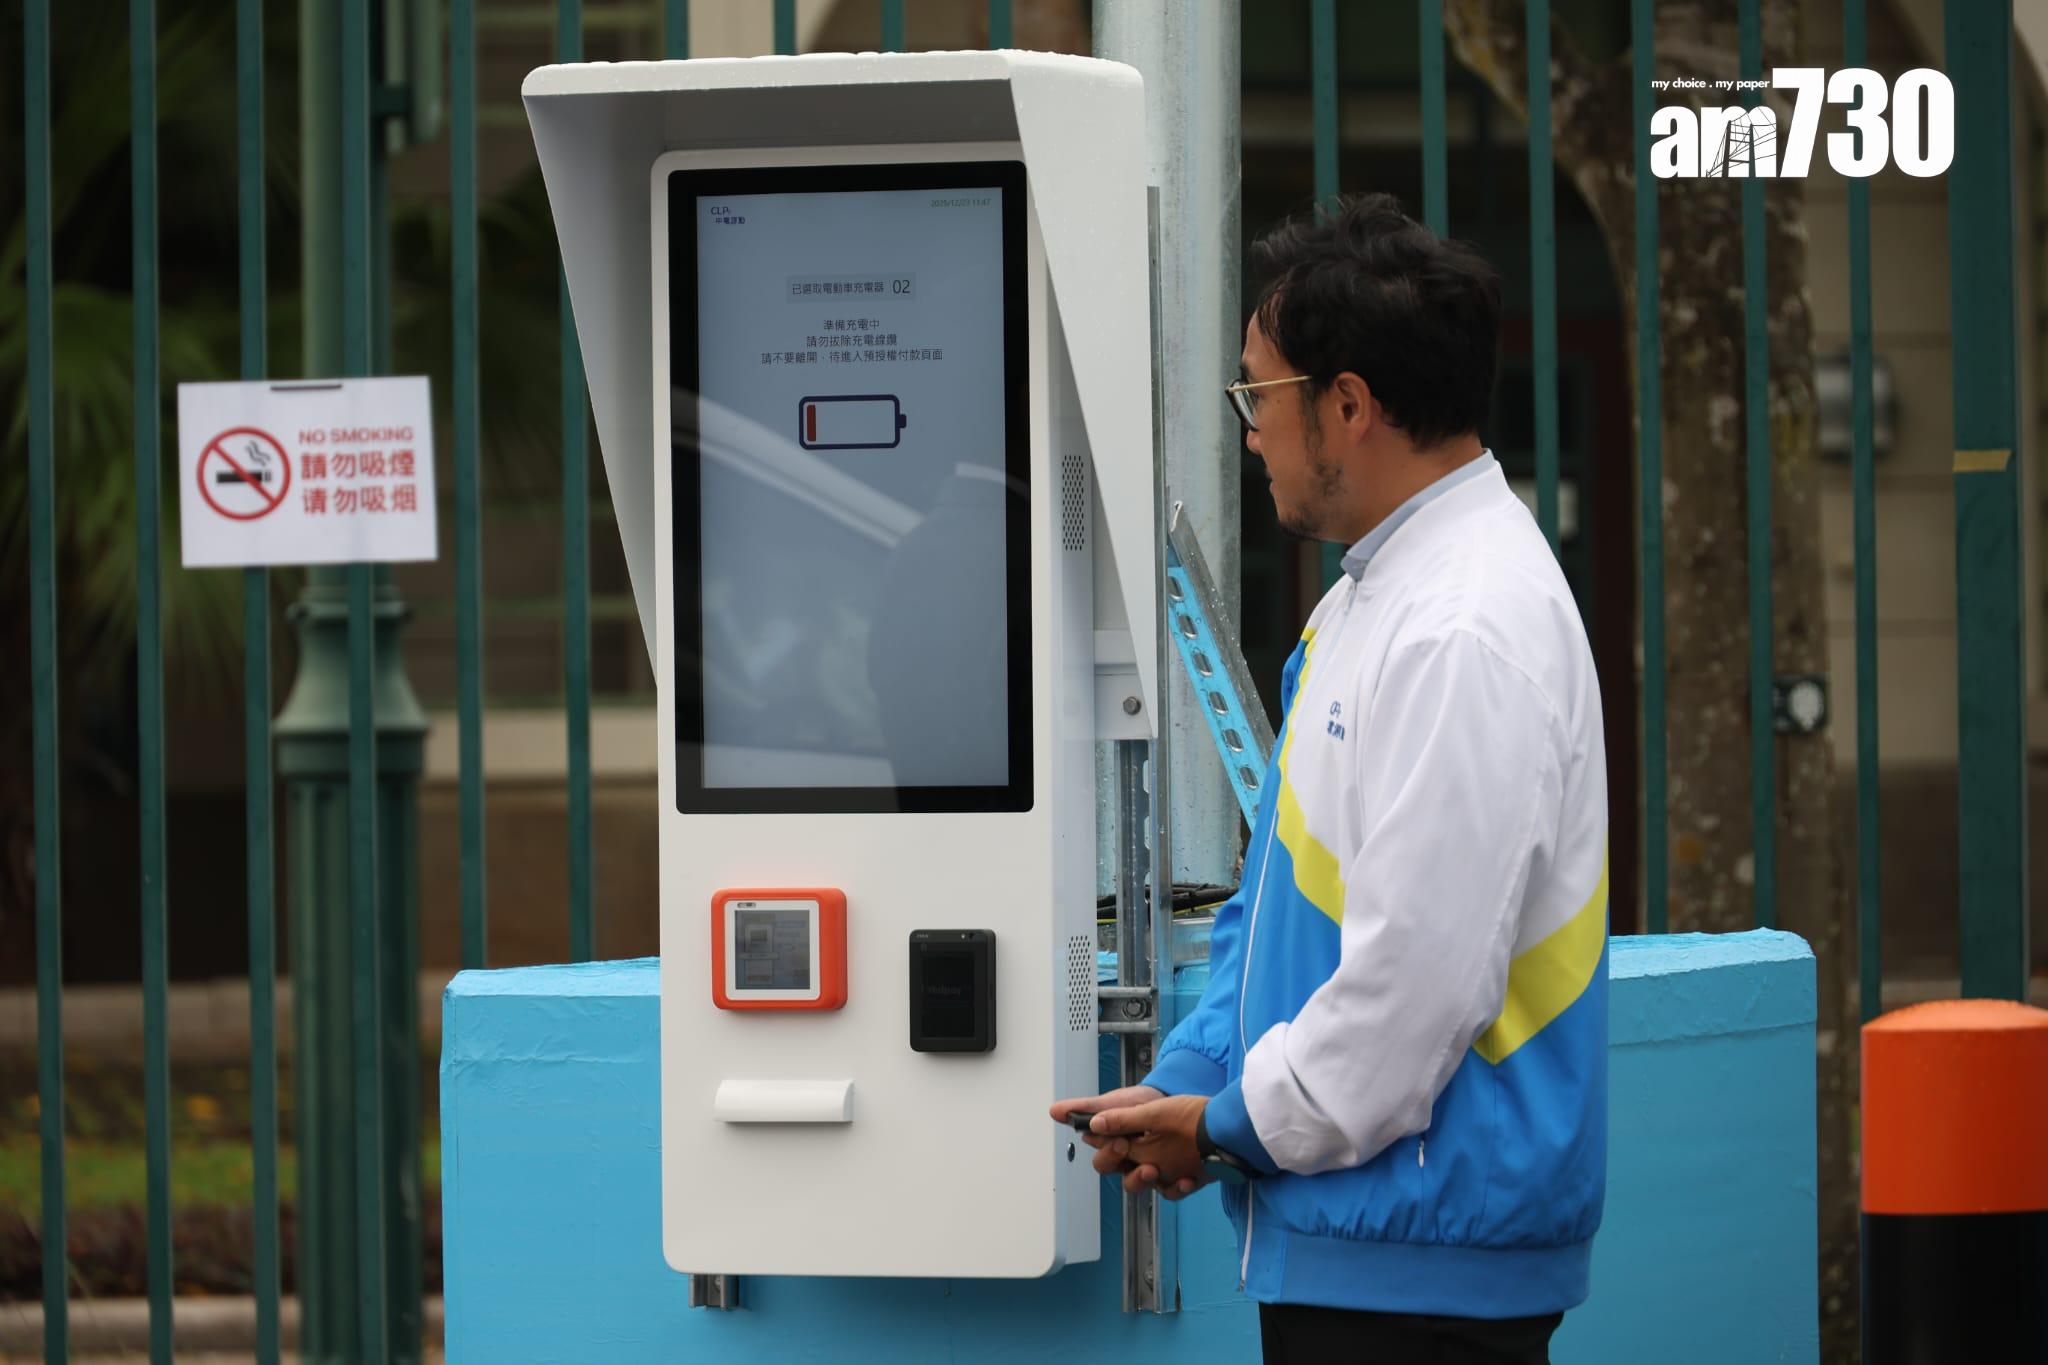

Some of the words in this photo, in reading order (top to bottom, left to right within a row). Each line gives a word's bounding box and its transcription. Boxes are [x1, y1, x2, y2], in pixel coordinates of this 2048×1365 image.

[792, 281, 884, 295] 已選取電動車充電器
[892, 279, 911, 294] 02
[823, 318, 880, 332] 準備充電中
[299, 428, 326, 443] NO
[331, 427, 414, 442] SMOKING
[301, 450, 415, 479] 請勿吸煙
[303, 484, 417, 513] 请勿吸烟
